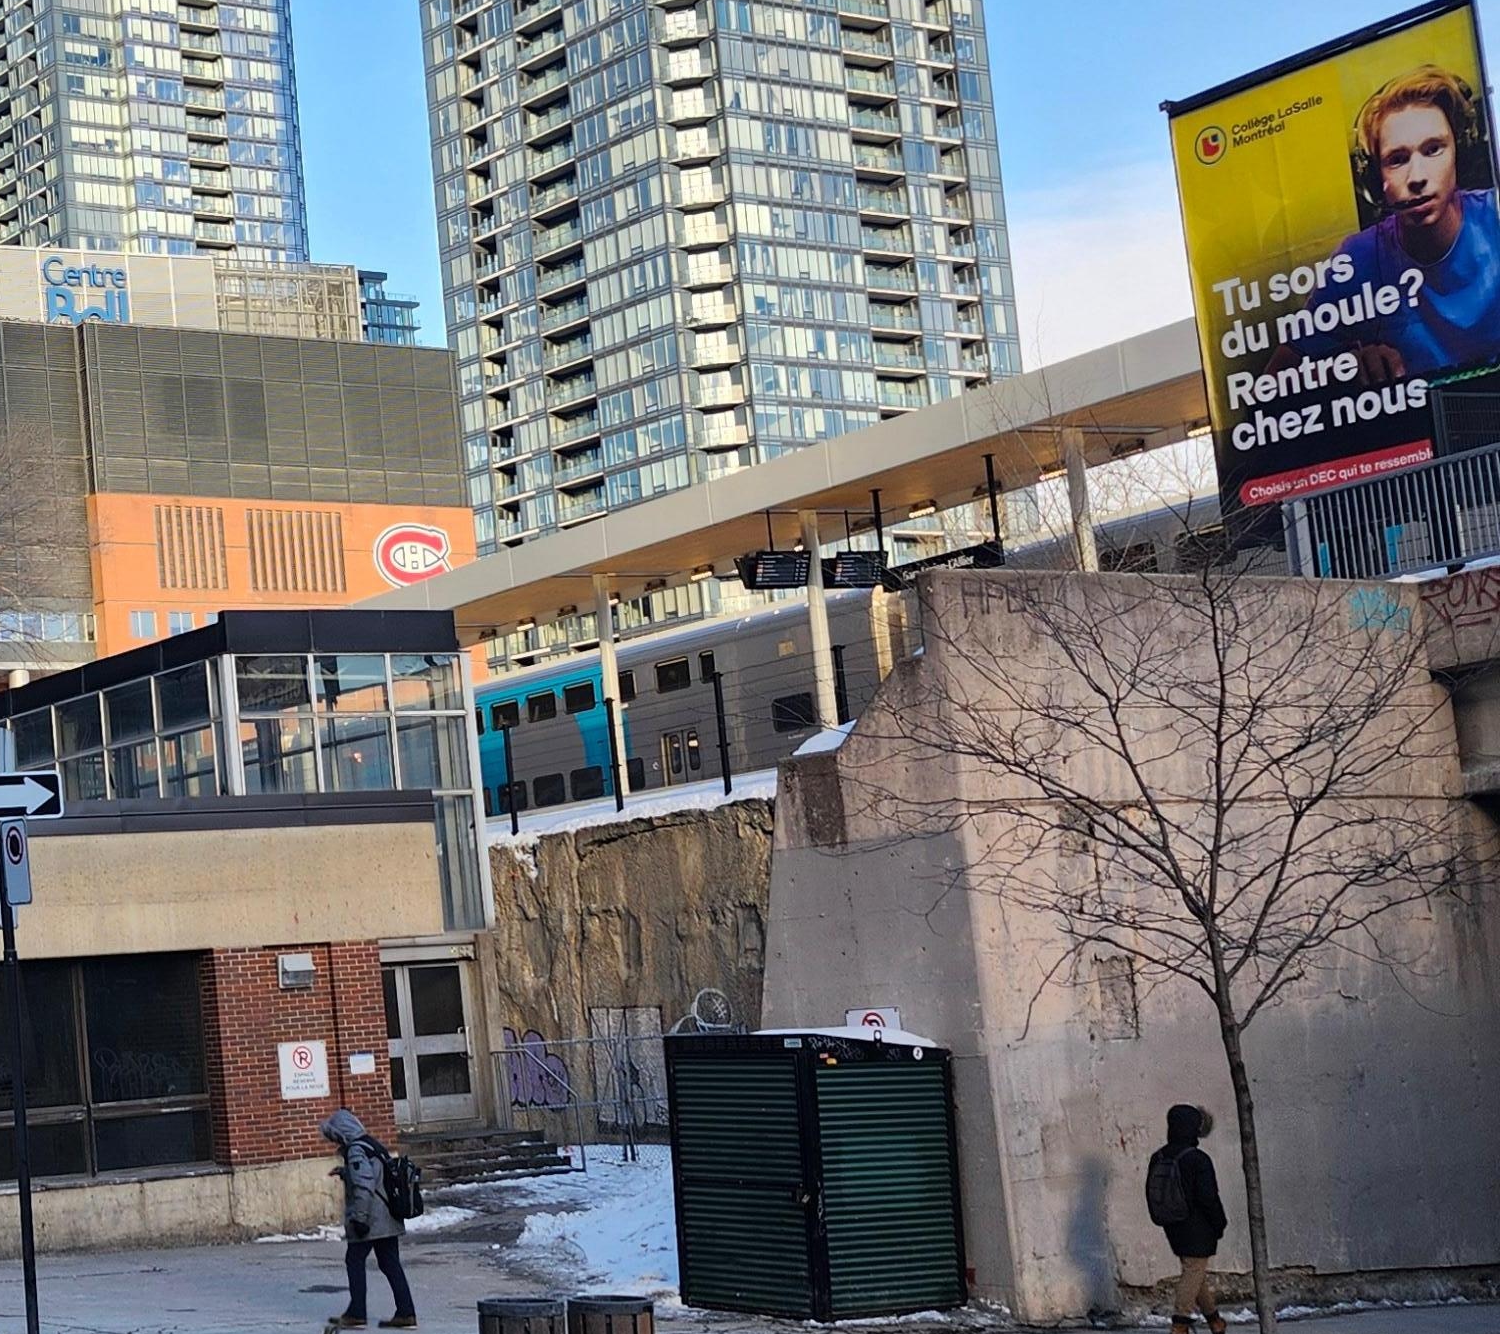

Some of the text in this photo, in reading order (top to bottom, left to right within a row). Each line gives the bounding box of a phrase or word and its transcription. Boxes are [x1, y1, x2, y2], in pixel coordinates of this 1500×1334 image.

[1232, 96, 1323, 135] Collège LaSalle
[1233, 120, 1285, 147] Montréal
[43, 255, 127, 288] Centre
[1212, 253, 1355, 316] Tu sors
[1221, 268, 1424, 358] du moule?
[1226, 352, 1359, 409] Rentre
[1232, 378, 1429, 451] chez nous
[1249, 447, 1434, 499] Choisis un DEC qui te ressembl
